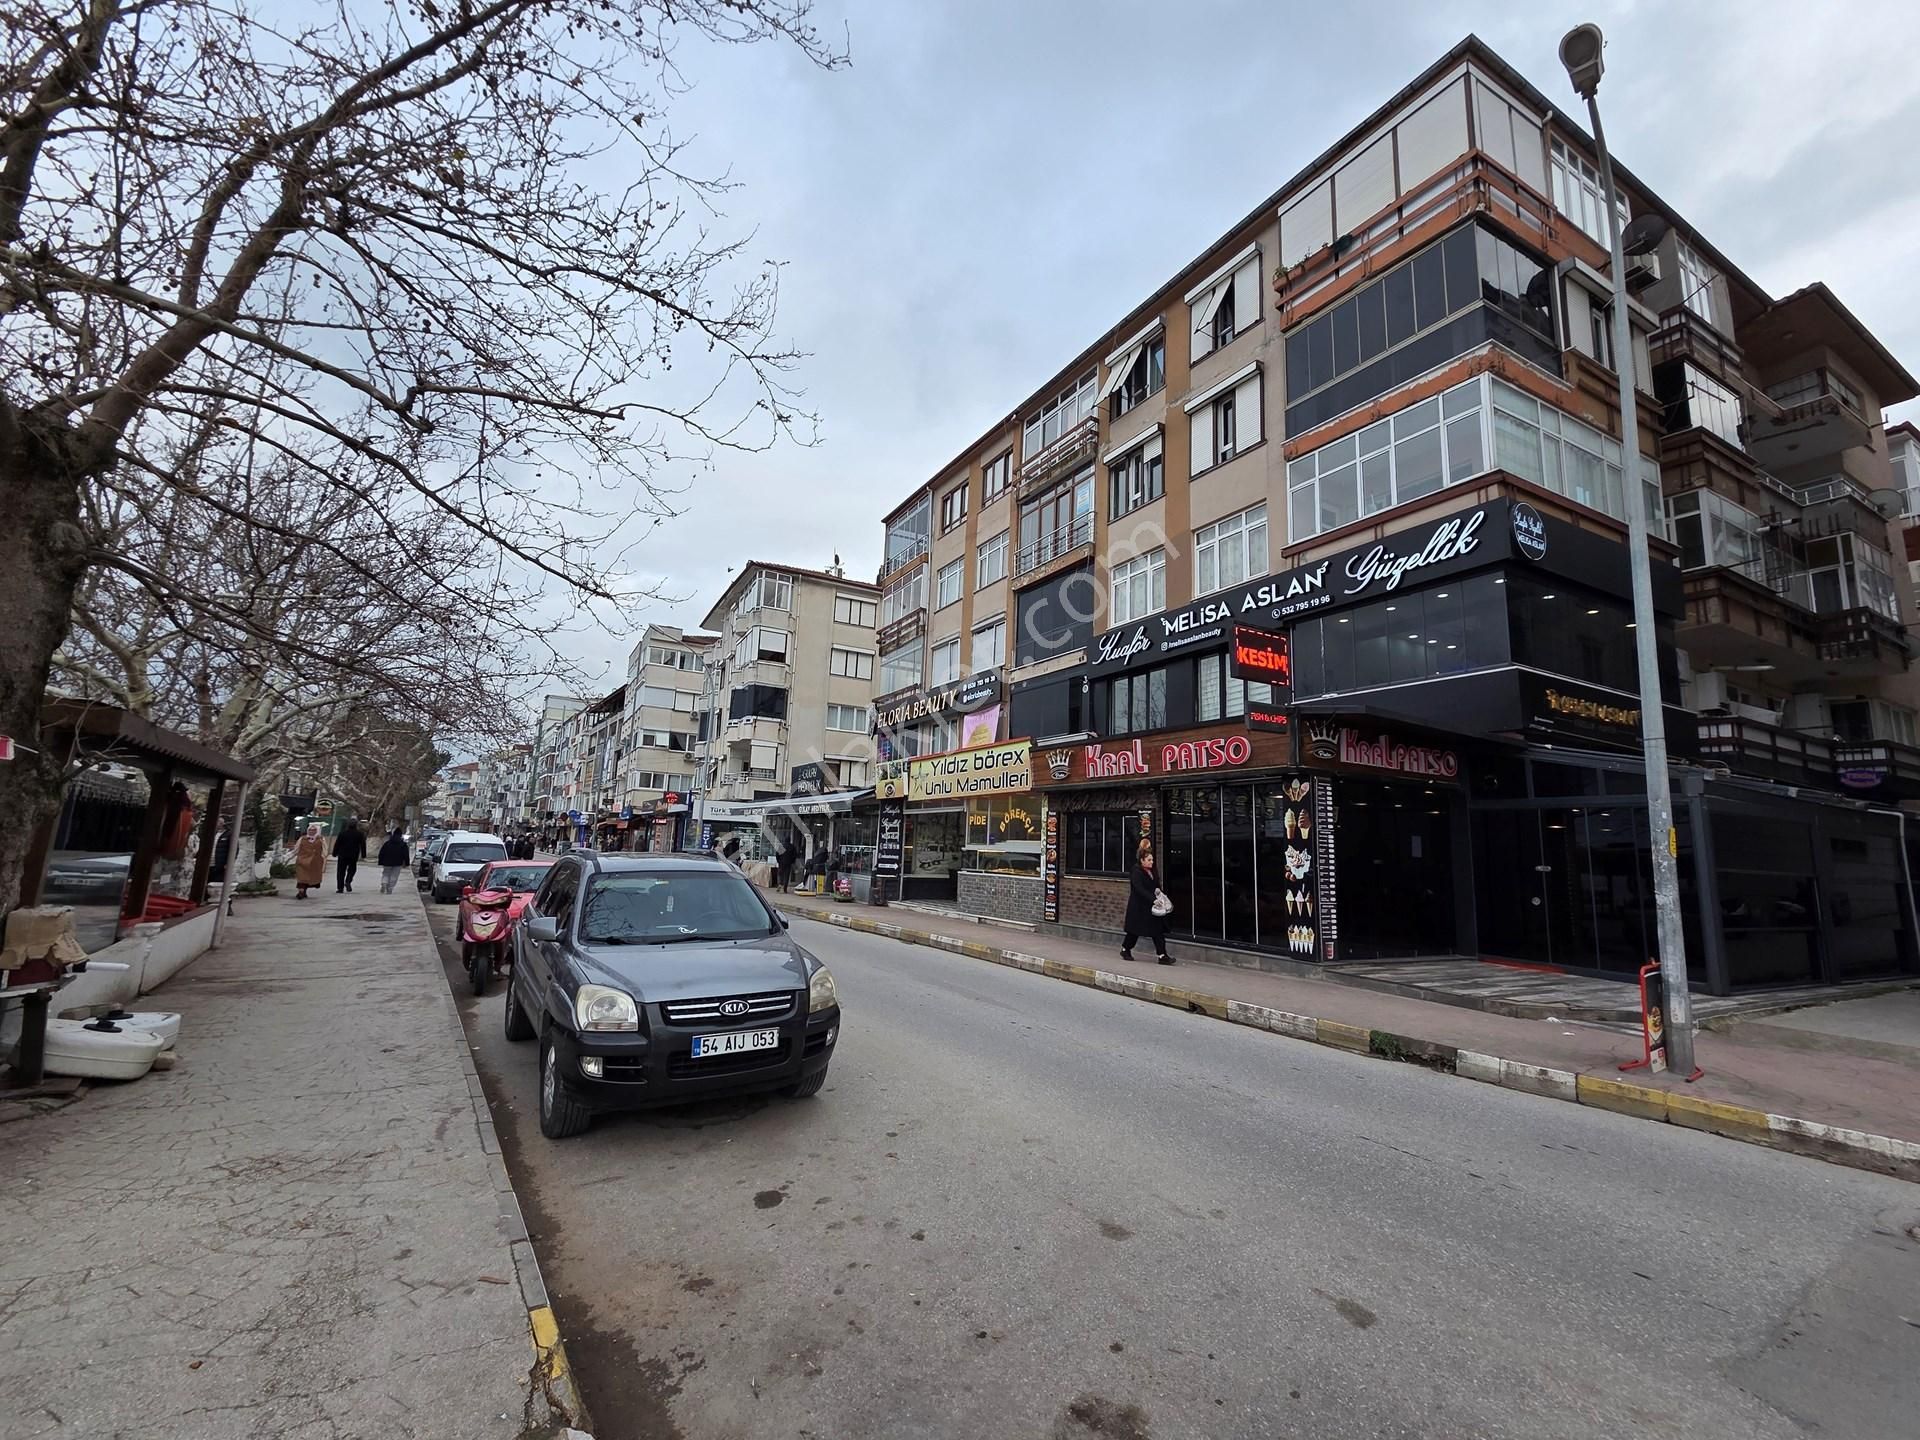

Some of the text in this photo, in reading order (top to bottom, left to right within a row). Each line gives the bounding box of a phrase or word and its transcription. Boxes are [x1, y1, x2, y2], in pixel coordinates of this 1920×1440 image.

[1344, 510, 1485, 594] Güzellik
[1241, 563, 1326, 613] ASLAN
[1281, 594, 1330, 615] 532 795 19 96
[1092, 625, 1151, 666] Kuaför
[1238, 646, 1288, 671] KESİM
[877, 704, 911, 729] ELORIA
[913, 688, 957, 719] BEAUTY
[974, 749, 1025, 771] börex
[1162, 735, 1251, 772] PATSO
[925, 769, 1029, 796] Unlu Mamulleri
[725, 1003, 745, 1013] KIA
[702, 1038, 718, 1054] 54
[725, 1034, 745, 1051] AIJ
[752, 1031, 775, 1047] 053
